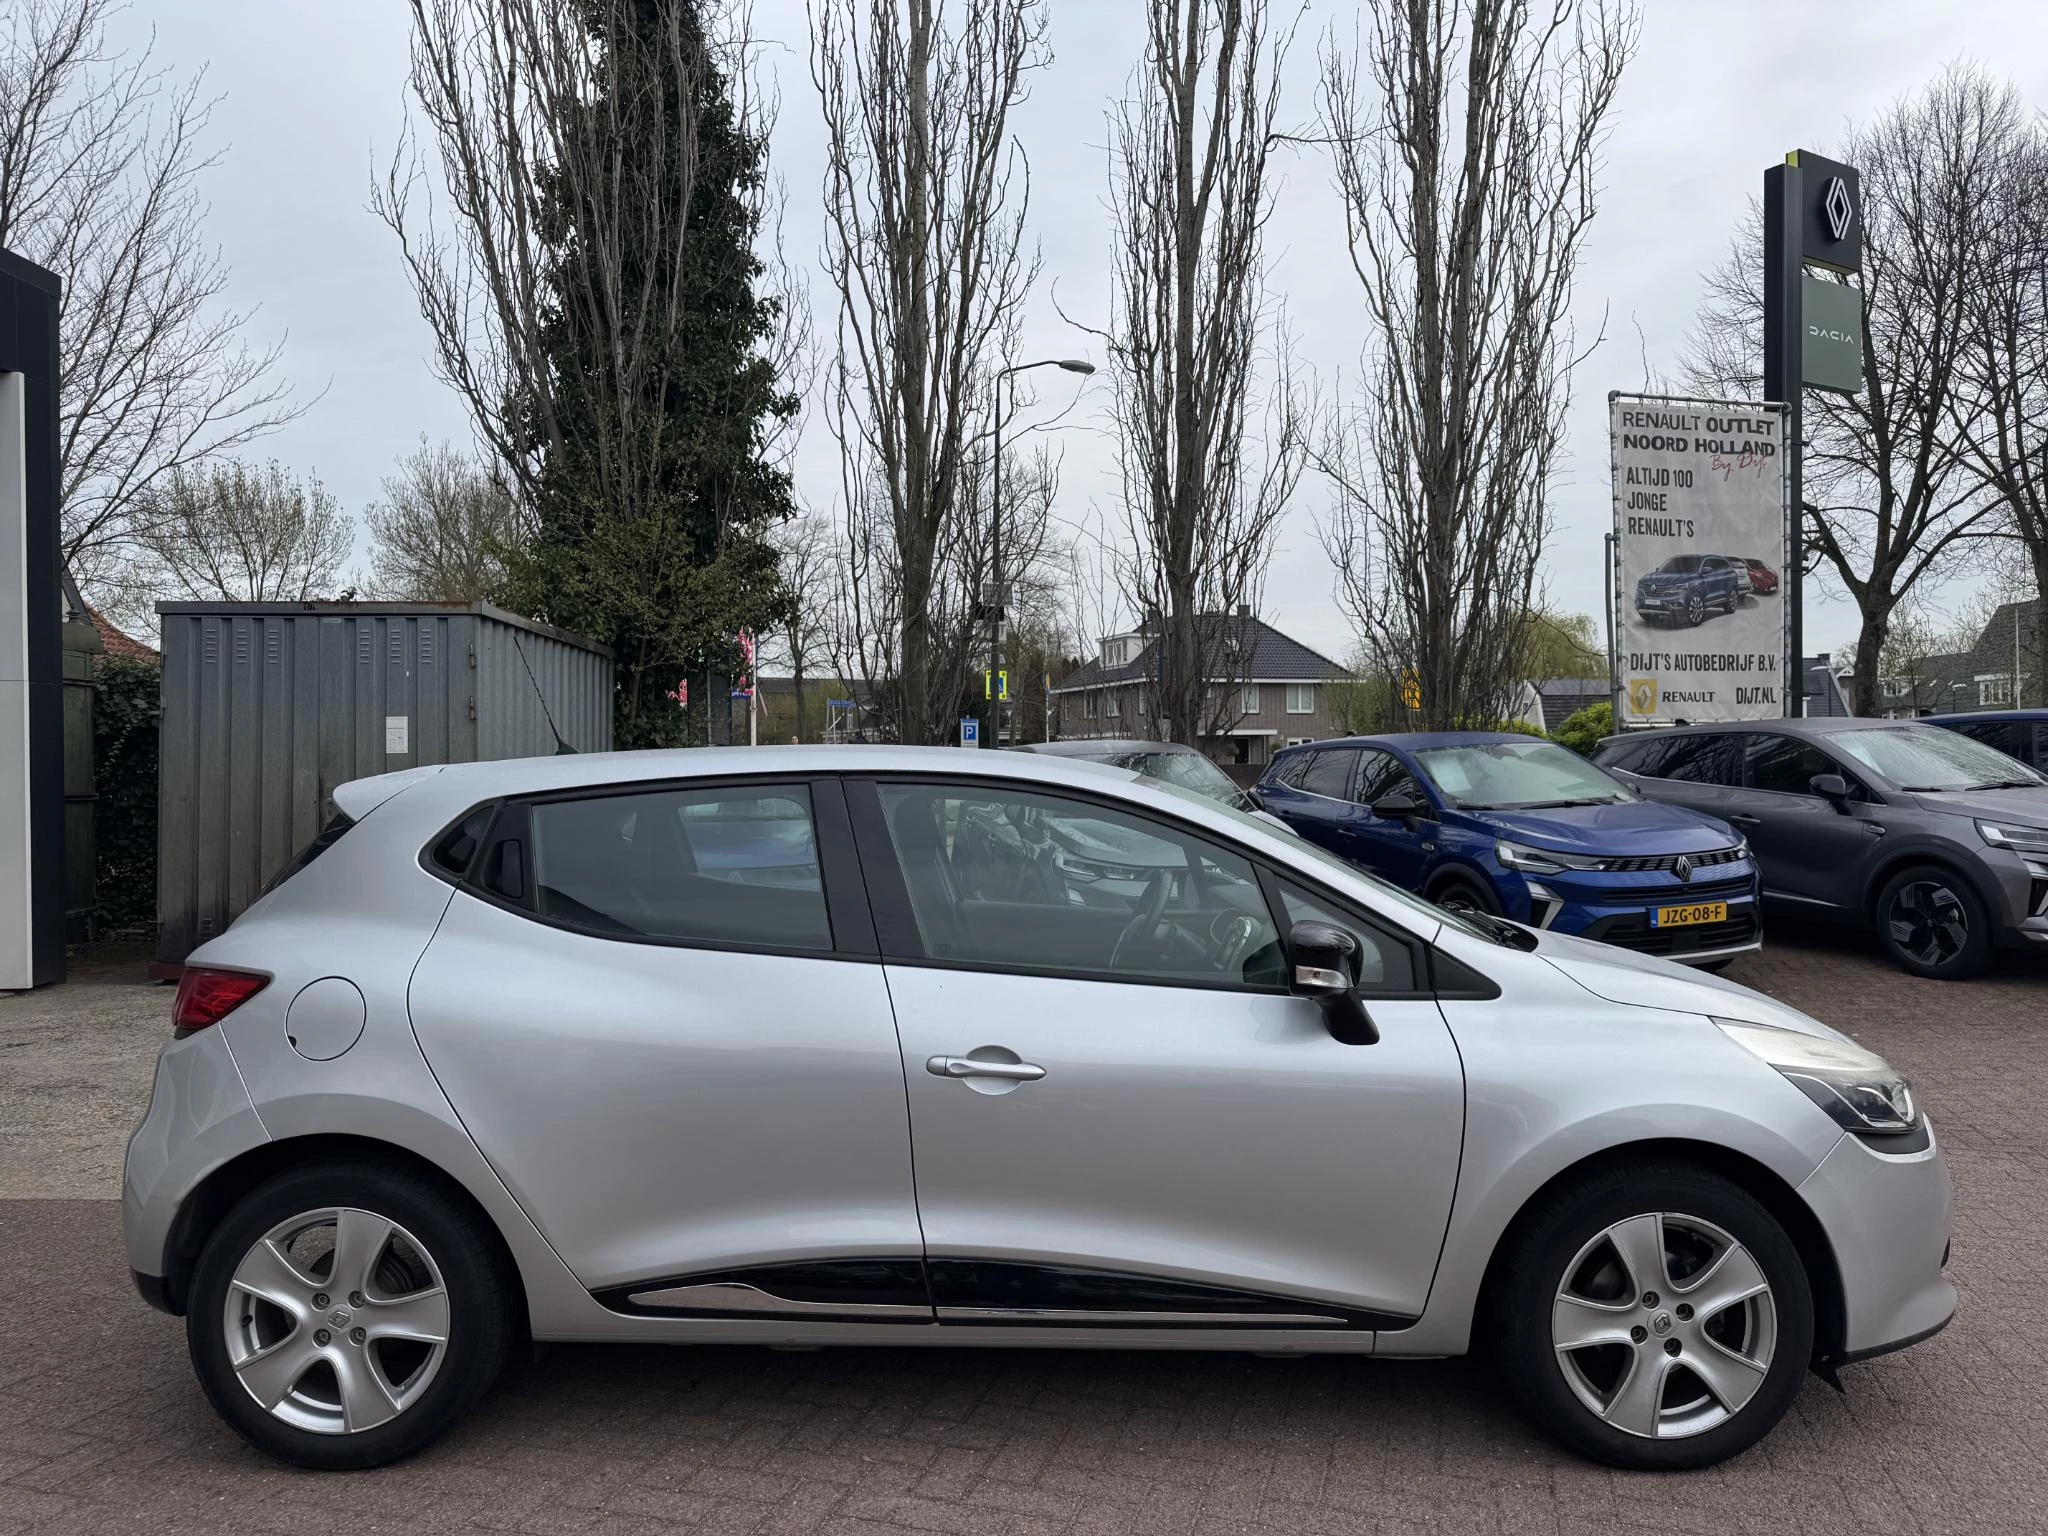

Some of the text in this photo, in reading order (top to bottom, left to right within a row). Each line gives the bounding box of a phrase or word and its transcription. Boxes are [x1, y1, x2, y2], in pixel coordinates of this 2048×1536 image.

[1809, 325, 1854, 344] DACIA
[1622, 411, 1775, 435] RENAULT OUTLET
[1623, 434, 1776, 457] NOORD HOLLAND
[1626, 466, 1693, 488] ALTIJD 100
[1710, 454, 1733, 482] By
[1627, 491, 1667, 511] JONGE
[1628, 516, 1695, 538] RENAULT'S
[1630, 653, 1777, 672] DIJT'S AUTOBEDRIJF B.V.
[1662, 691, 1716, 703] RENAULT
[1736, 686, 1777, 704] DIJT.NL
[966, 726, 974, 739] P
[1663, 905, 1722, 924] JZG-08-F
